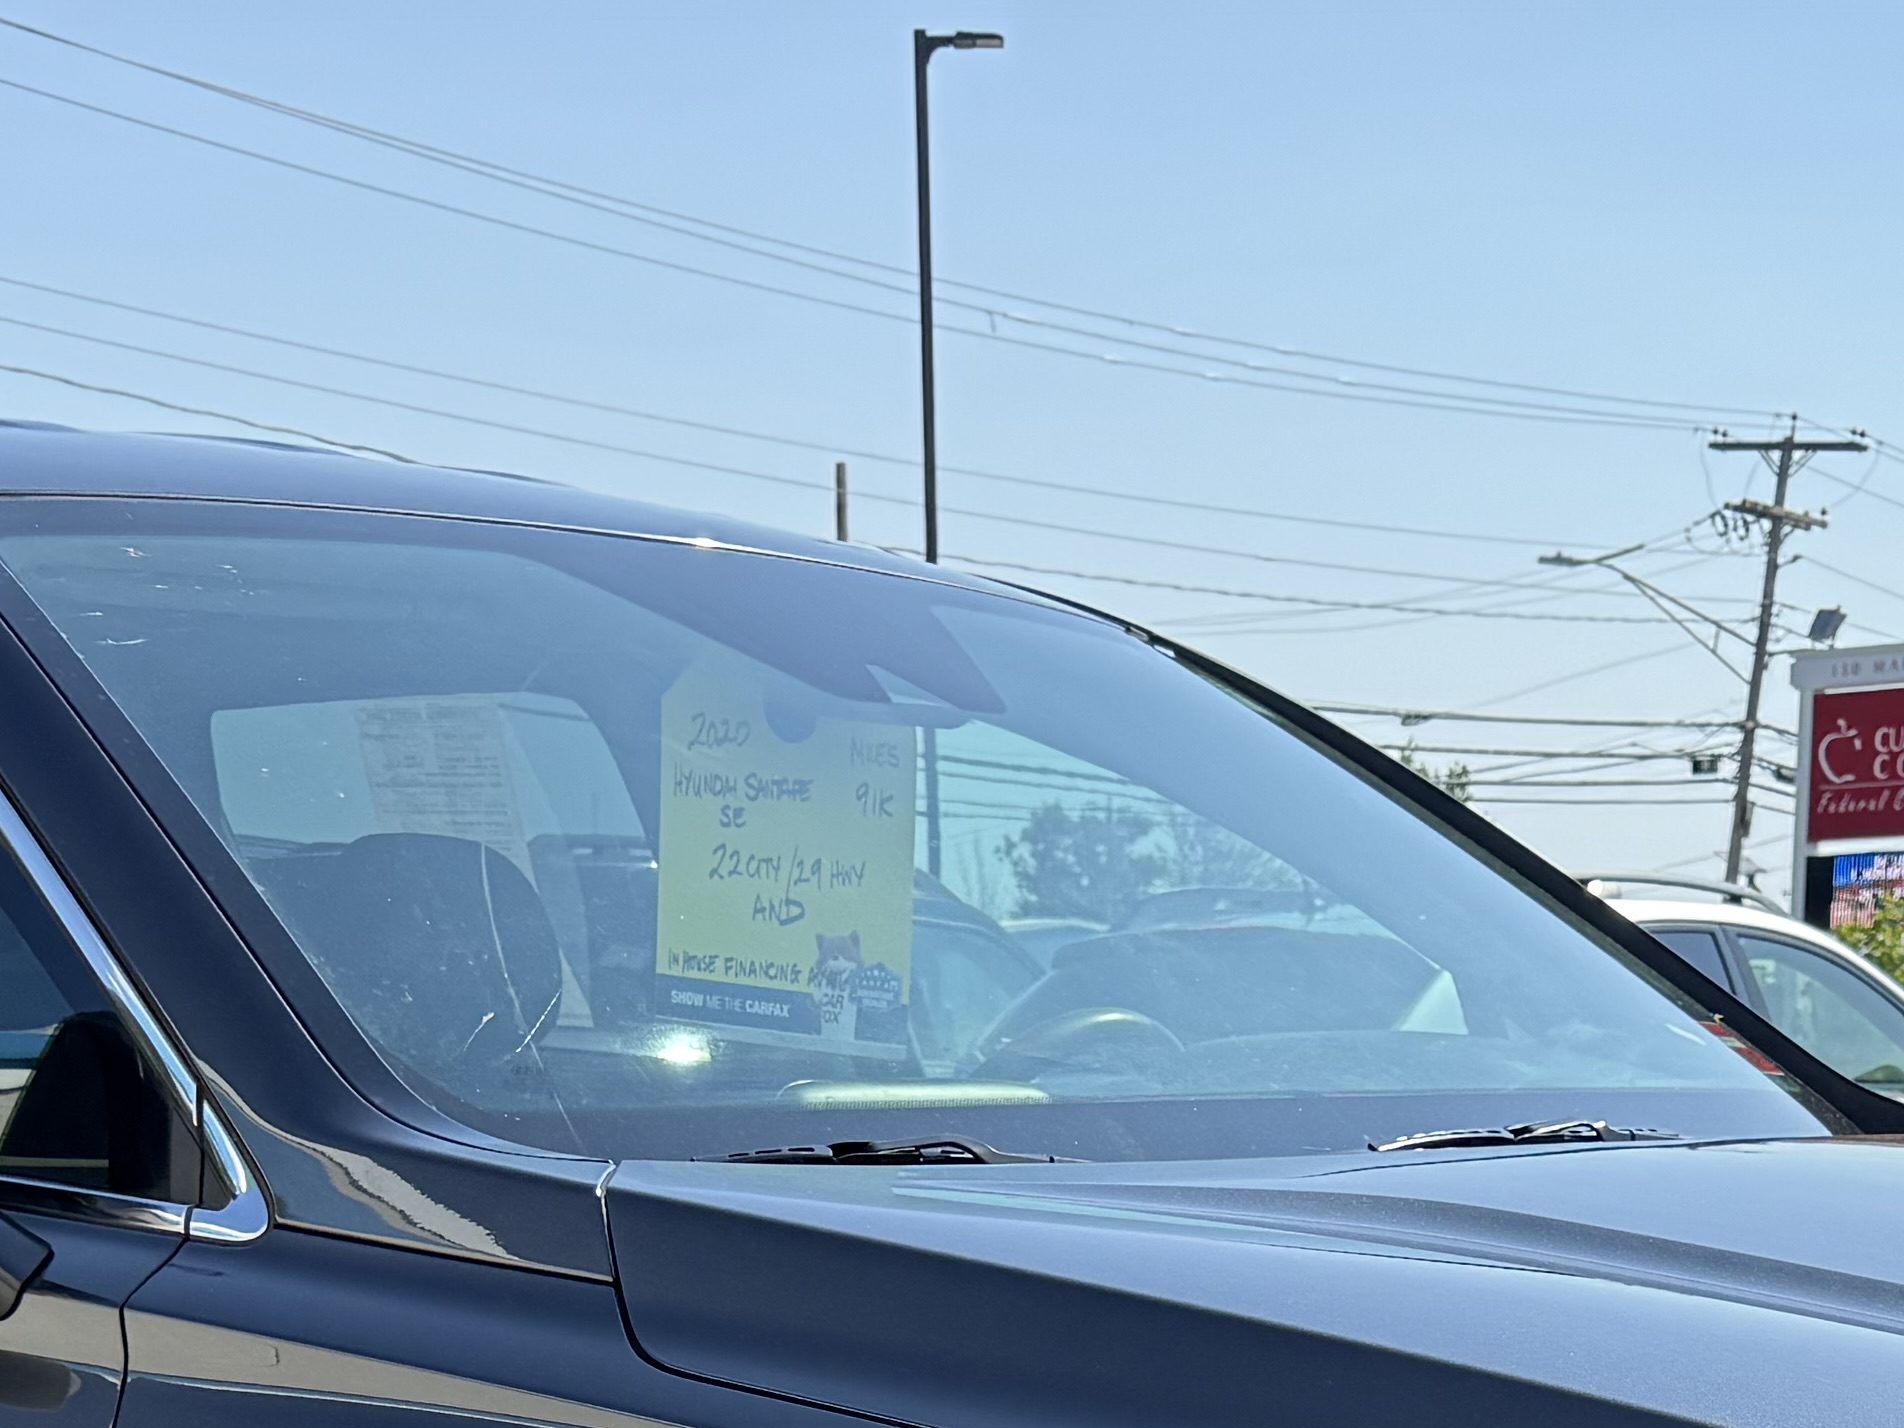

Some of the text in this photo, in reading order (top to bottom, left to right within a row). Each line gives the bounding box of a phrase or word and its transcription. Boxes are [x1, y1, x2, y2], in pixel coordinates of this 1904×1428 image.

[687, 712, 751, 750] 2020
[849, 736, 900, 768] MILES
[1817, 788, 1891, 814] Federal
[719, 804, 746, 828] SE
[830, 860, 866, 889] HWY
[668, 948, 680, 971] IN
[724, 956, 803, 985] FINANCING
[671, 990, 791, 1019] SHOW ME THE CARFAX
